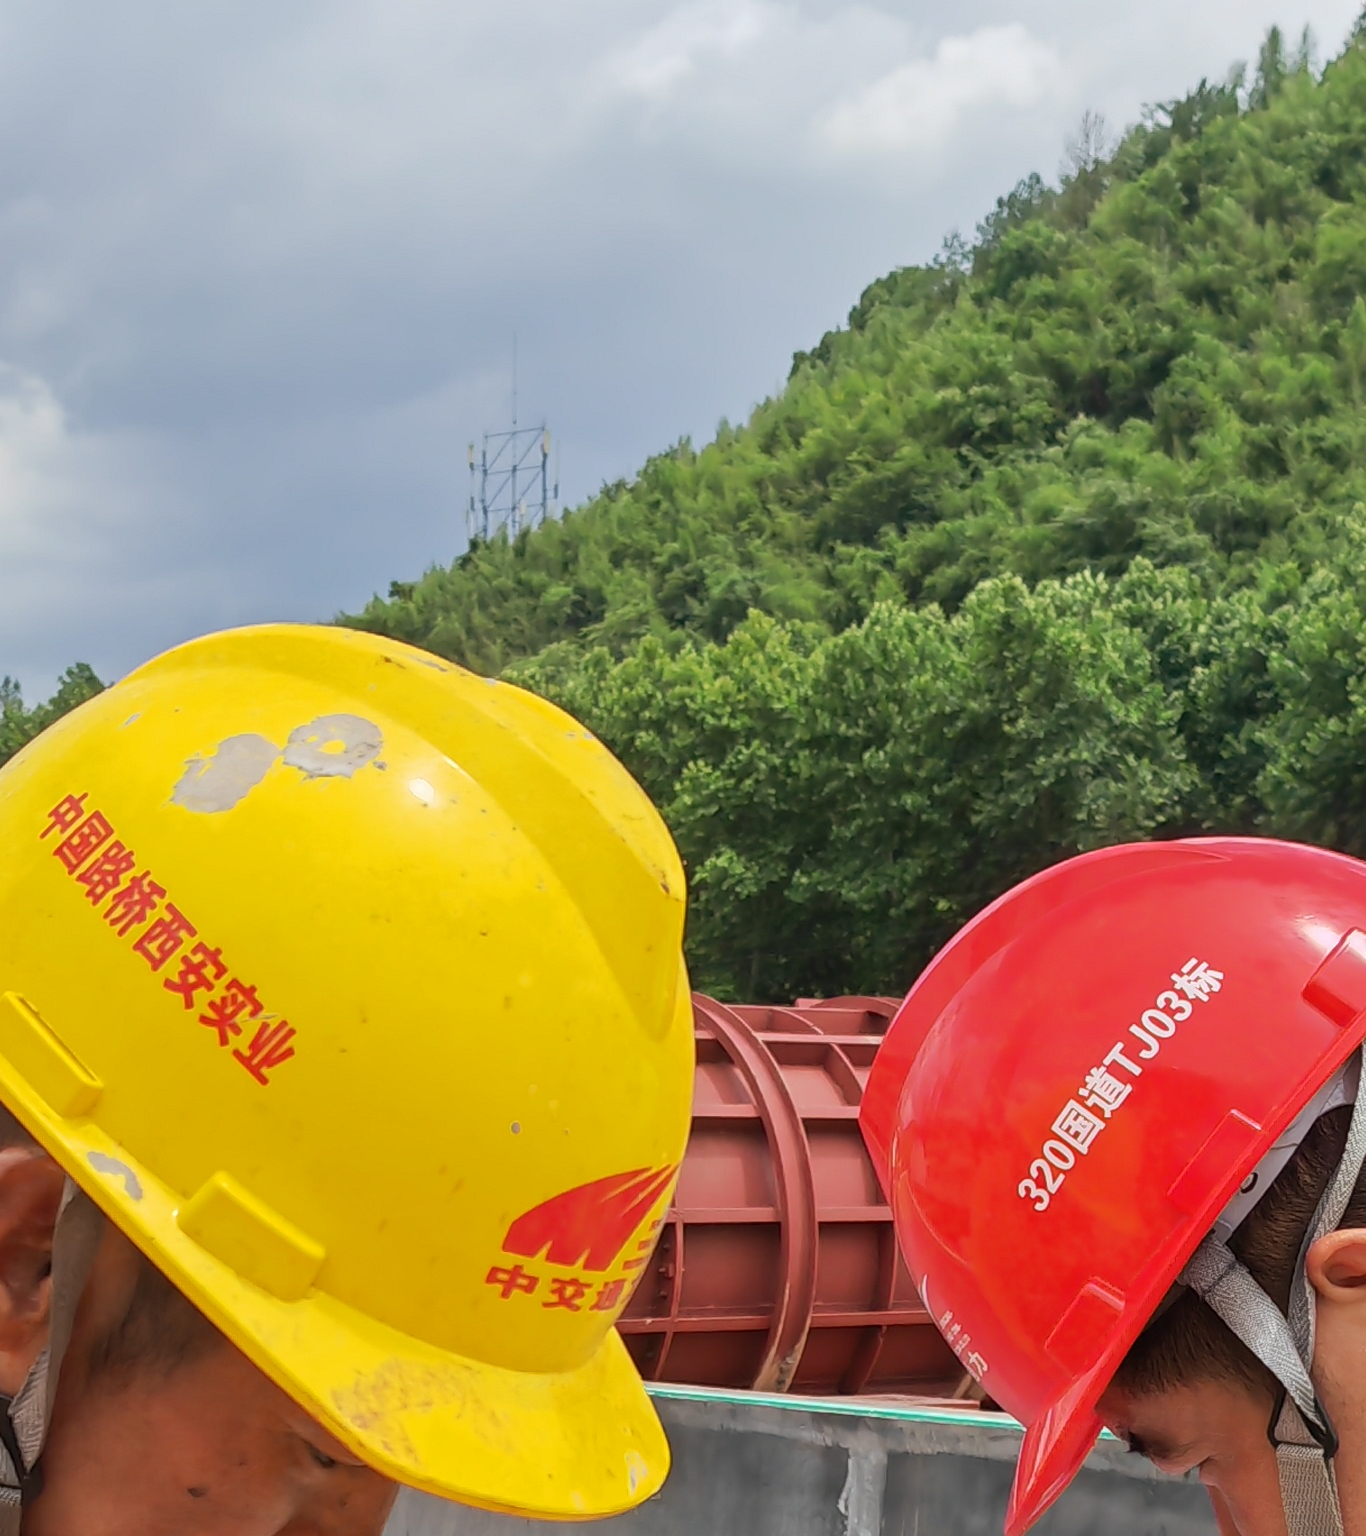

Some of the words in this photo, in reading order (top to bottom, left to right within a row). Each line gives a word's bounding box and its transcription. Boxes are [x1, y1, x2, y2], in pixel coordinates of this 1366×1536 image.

[39, 792, 297, 1086] 中国路桥西安实业
[1017, 957, 1224, 1212] 320国道TJ03标
[485, 1265, 633, 1312] 中交通
